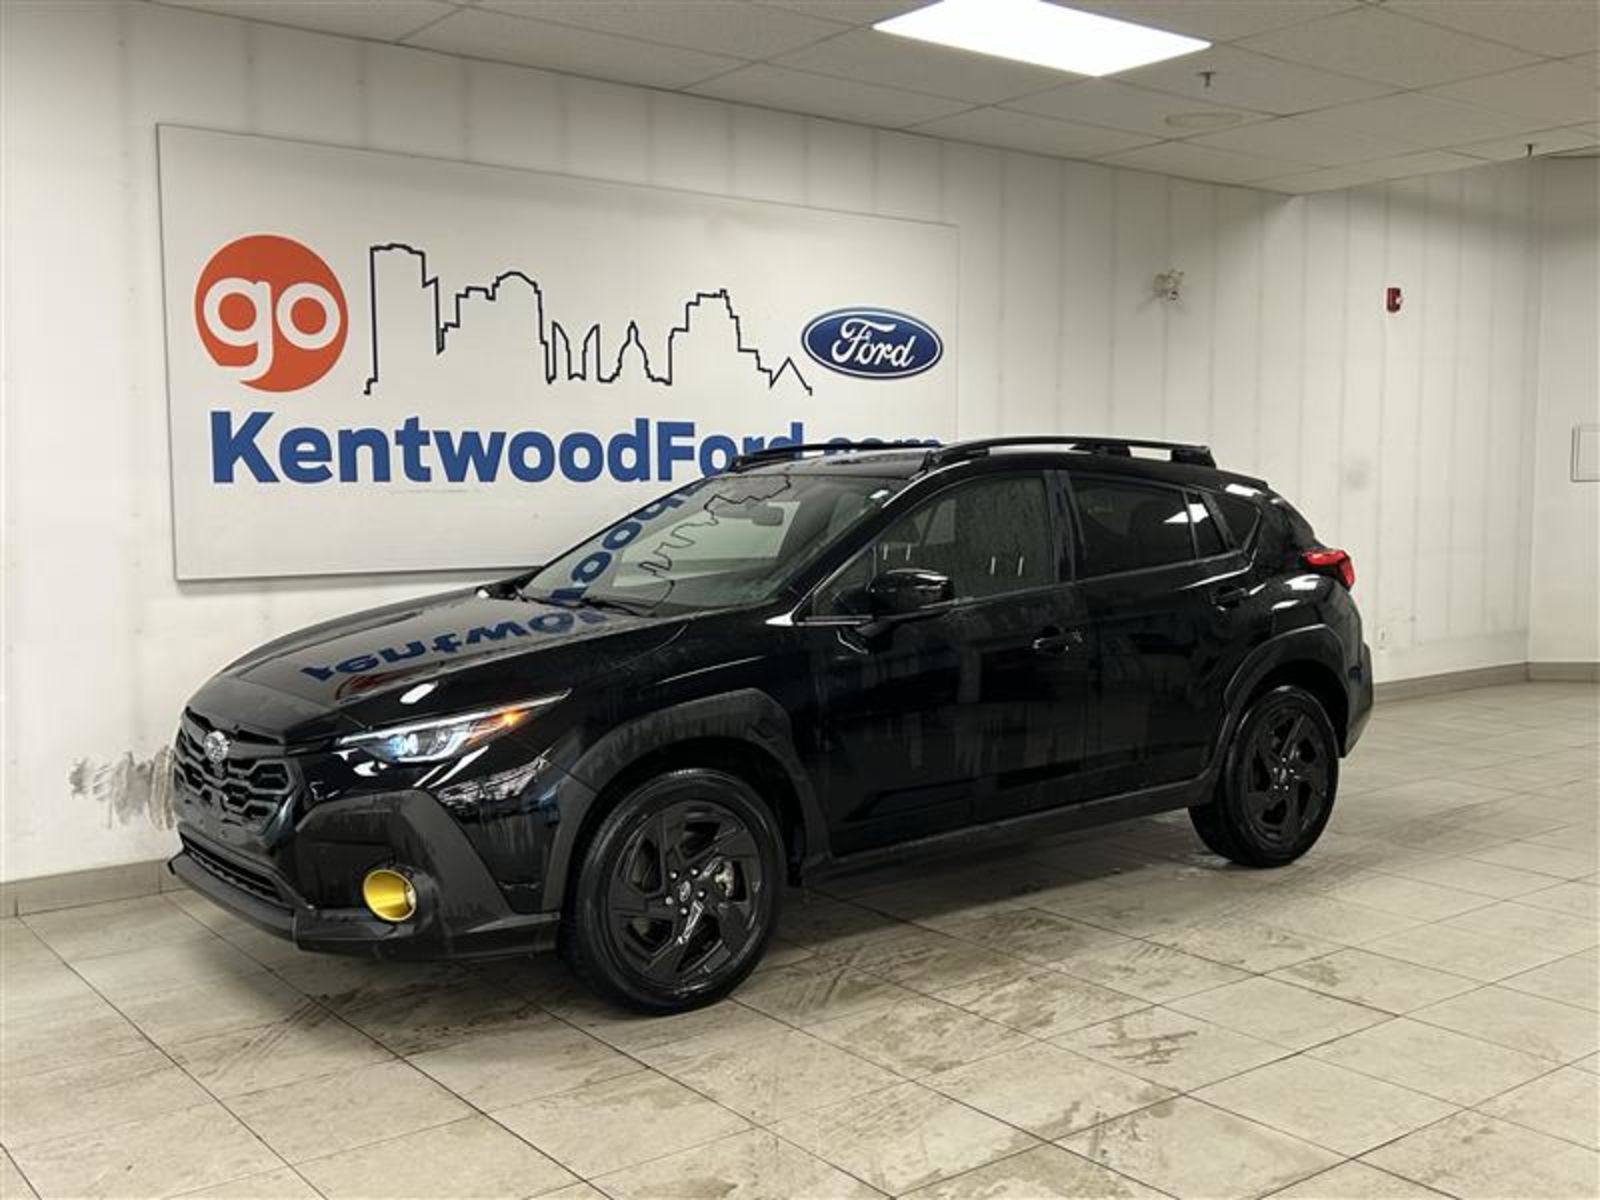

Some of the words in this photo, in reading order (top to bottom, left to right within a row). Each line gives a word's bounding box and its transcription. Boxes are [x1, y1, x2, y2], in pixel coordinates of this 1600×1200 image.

[203, 277, 342, 382] go
[831, 317, 917, 368] Ford
[211, 410, 942, 483] KentwoodFo
